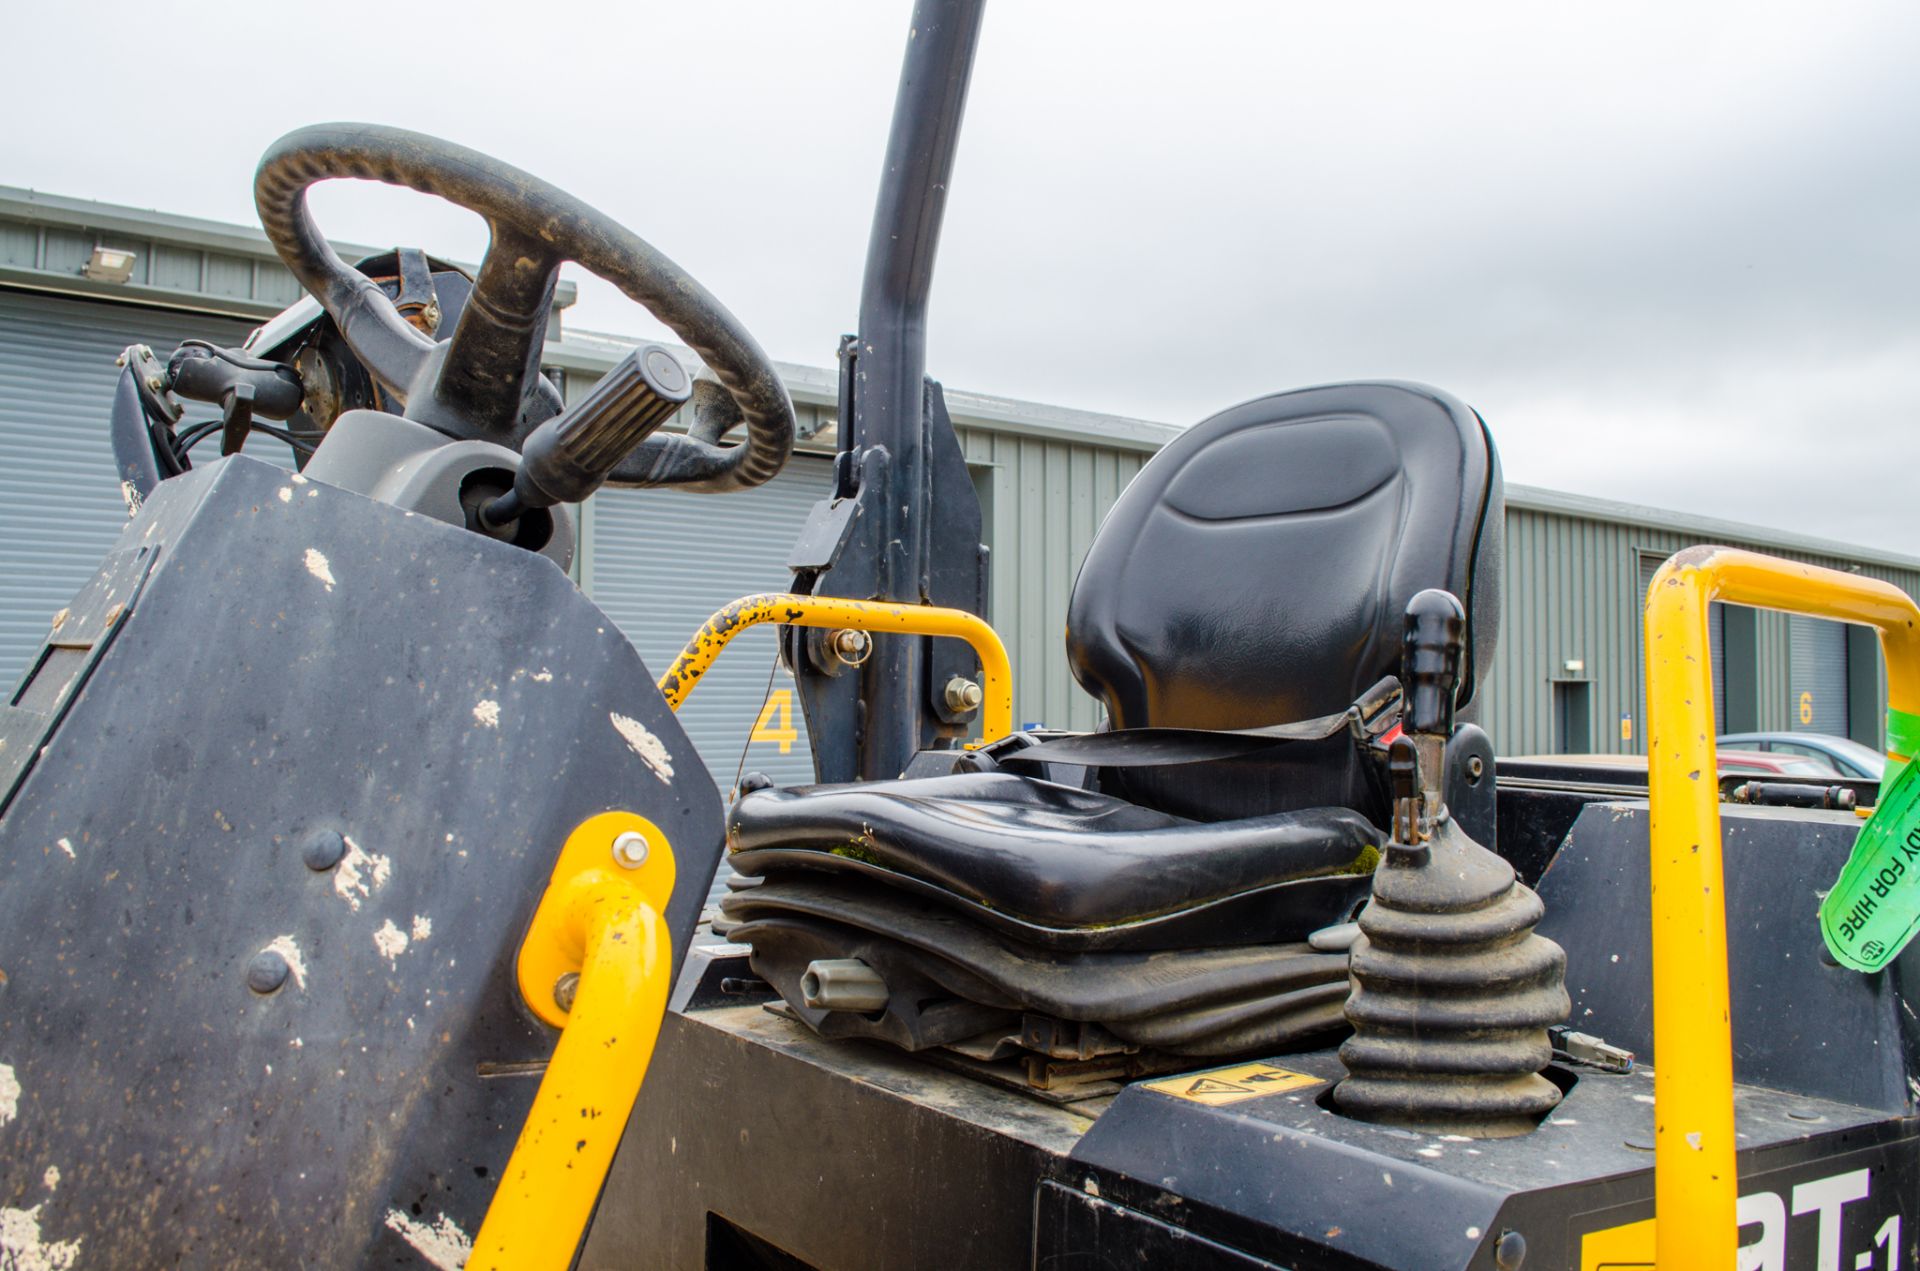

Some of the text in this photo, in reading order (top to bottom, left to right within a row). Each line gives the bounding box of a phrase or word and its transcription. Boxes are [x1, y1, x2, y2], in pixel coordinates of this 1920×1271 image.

[748, 689, 798, 754] 4
[1800, 692, 1812, 724] 6
[1869, 856, 1905, 898] FOR
[1839, 893, 1878, 942] HIRE
